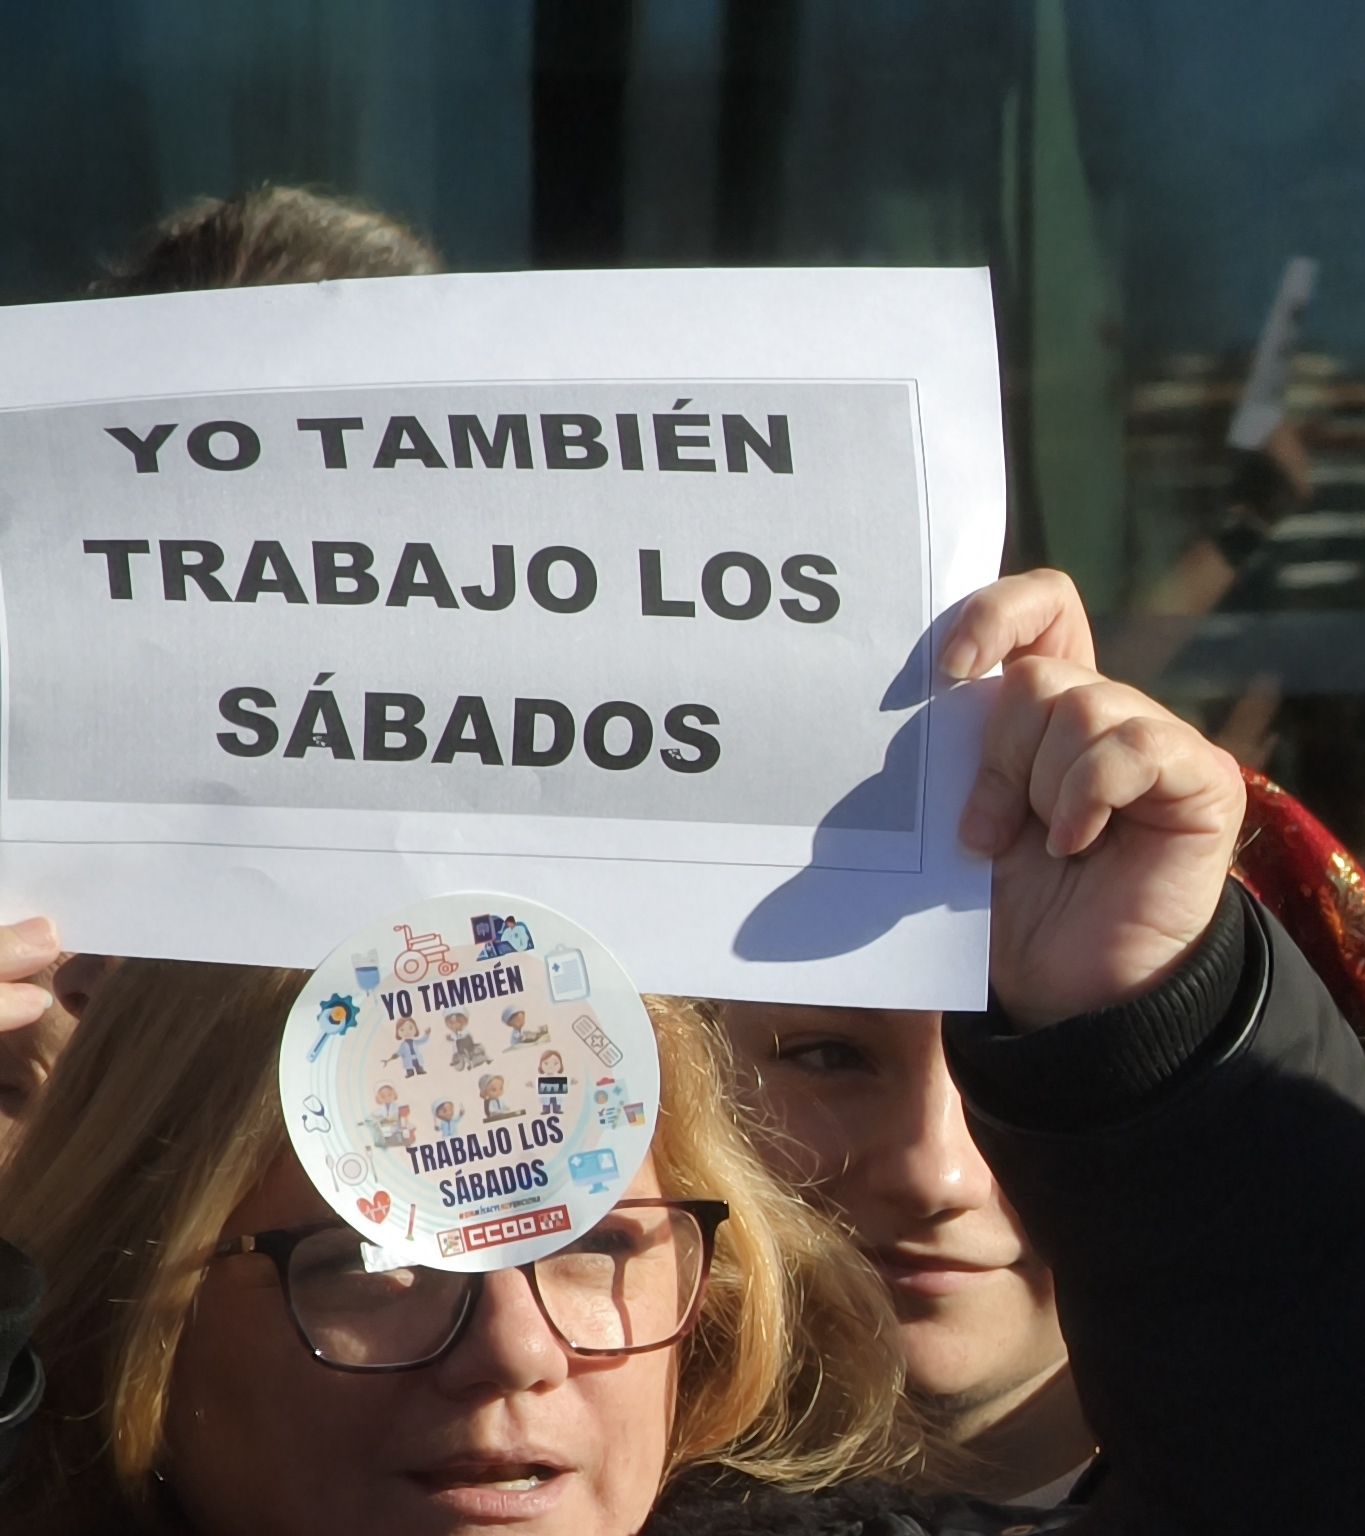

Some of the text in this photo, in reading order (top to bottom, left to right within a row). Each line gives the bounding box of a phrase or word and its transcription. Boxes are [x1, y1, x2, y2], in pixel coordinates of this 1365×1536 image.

[104, 398, 793, 475] YO TAMBIÉN
[83, 538, 840, 624] TRABAJO LOS
[216, 672, 722, 773] SÁBADOS
[381, 962, 525, 1021] YO TAMBIÉN
[406, 1116, 564, 1176] TRABAJO LOS
[439, 1159, 549, 1207] SÁBADOS
[468, 1217, 538, 1247] CCOO
